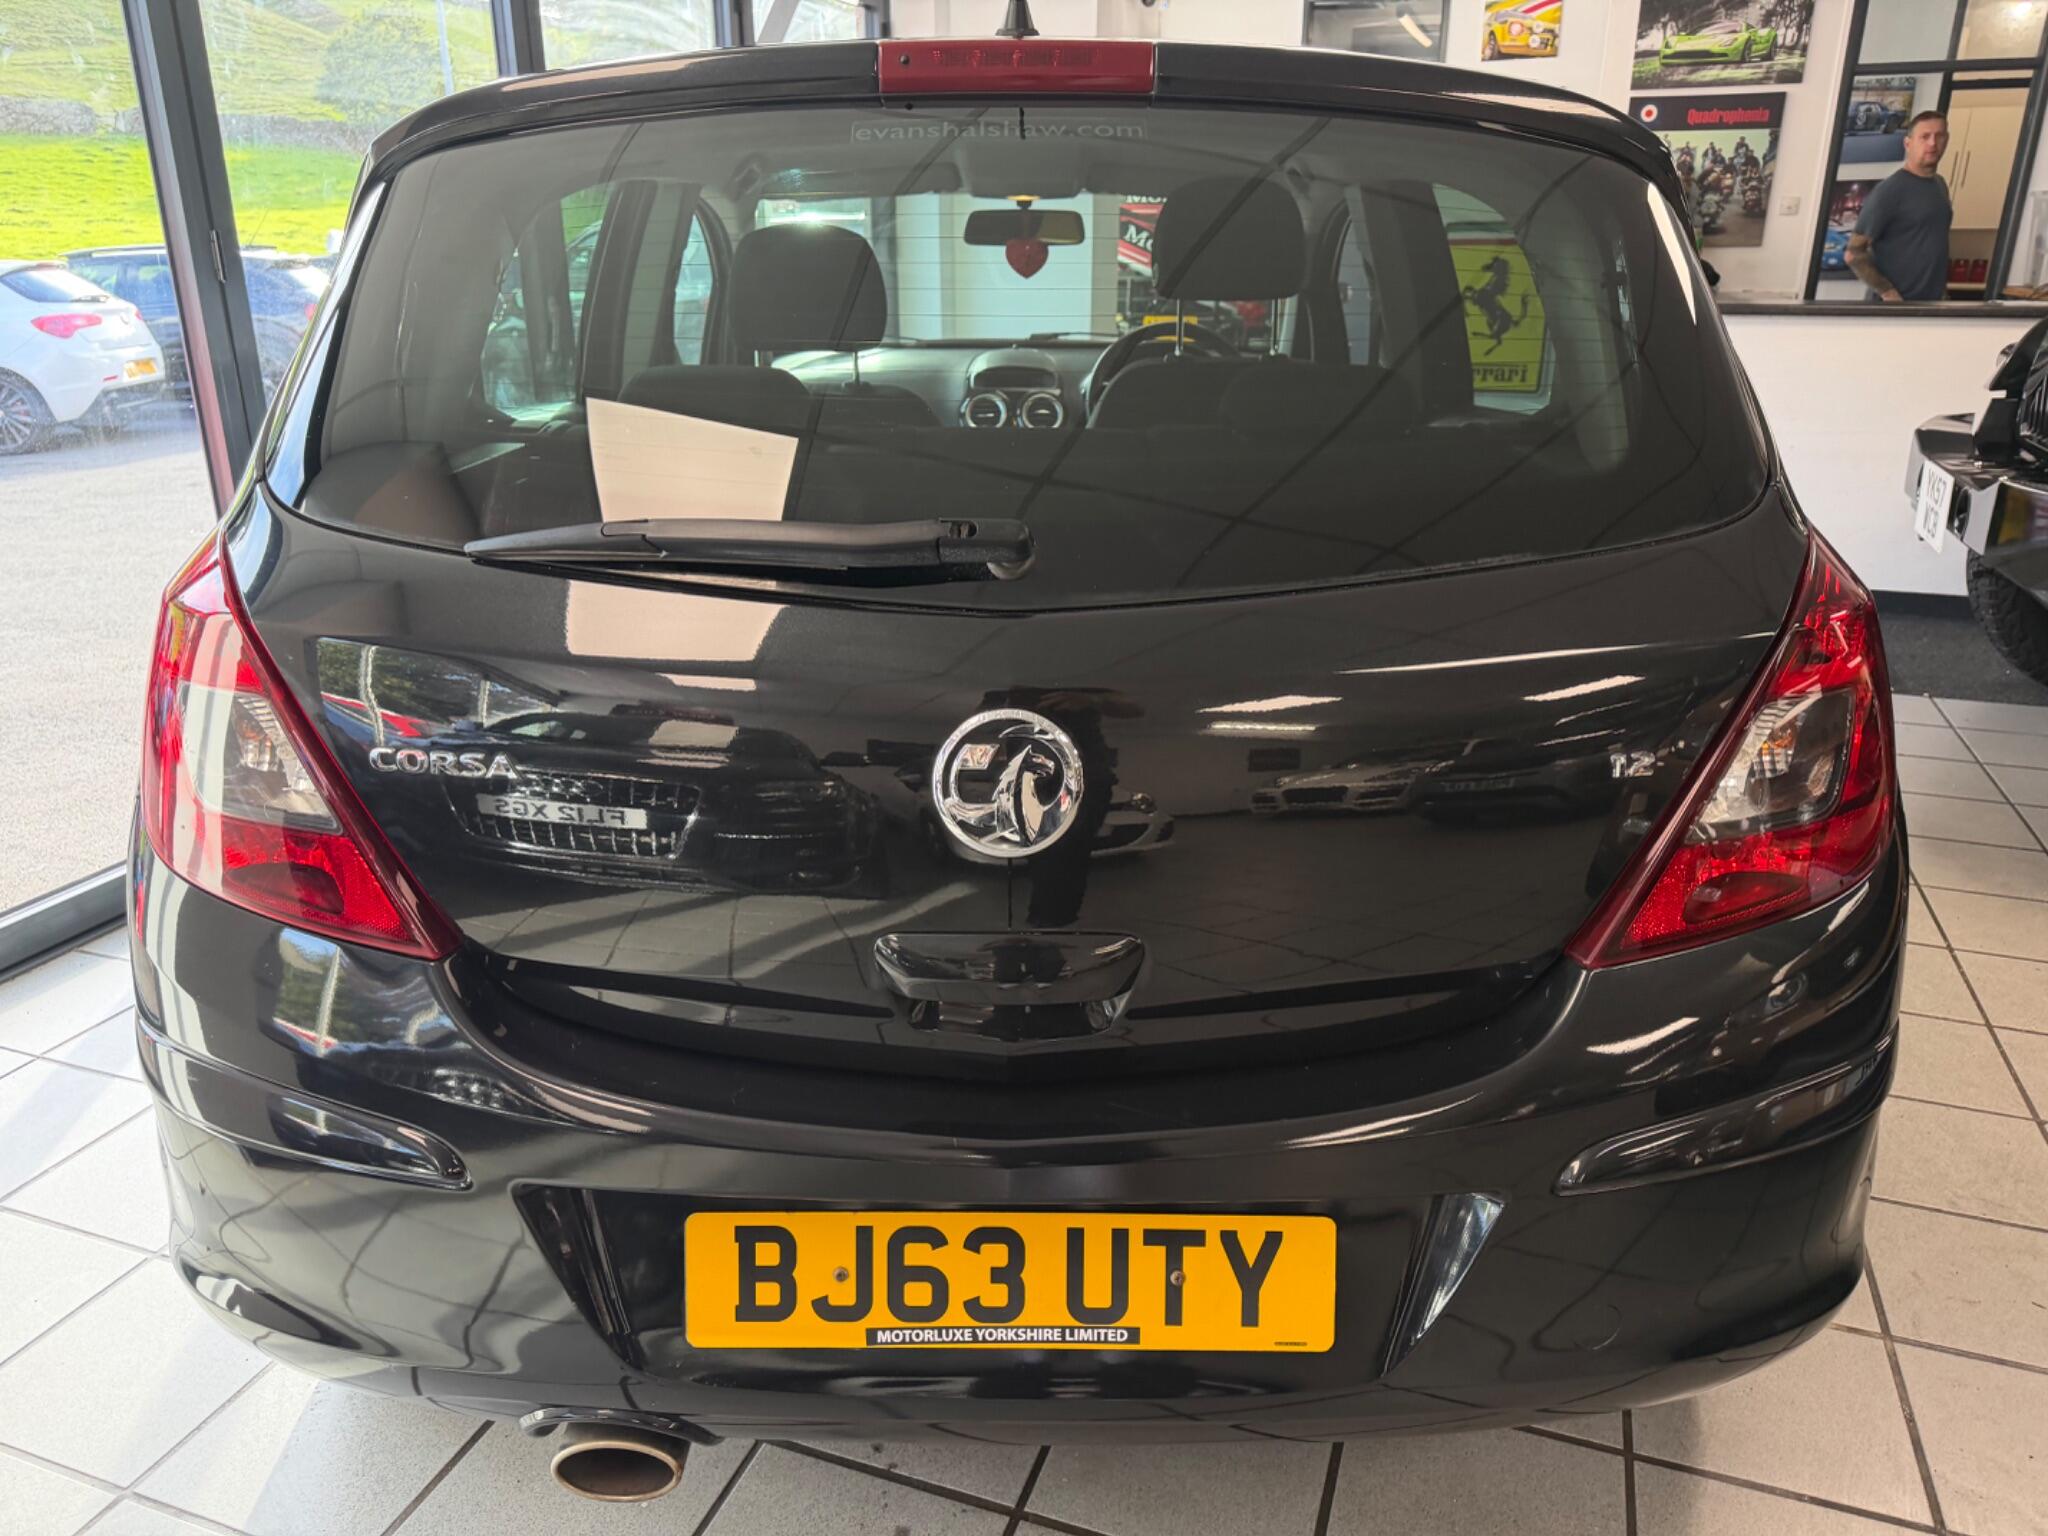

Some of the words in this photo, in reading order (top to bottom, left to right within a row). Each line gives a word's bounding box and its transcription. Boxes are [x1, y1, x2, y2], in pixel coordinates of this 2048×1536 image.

[855, 121, 1144, 141] evanshalshaw.com
[369, 747, 519, 779] CORSA
[734, 1225, 1026, 1324] BJ63
[1066, 1227, 1284, 1327] UTY
[877, 1328, 973, 1343] MOTORLUXE
[976, 1327, 1062, 1341] YORKSHIRE
[1065, 1328, 1129, 1342] LIMITED
